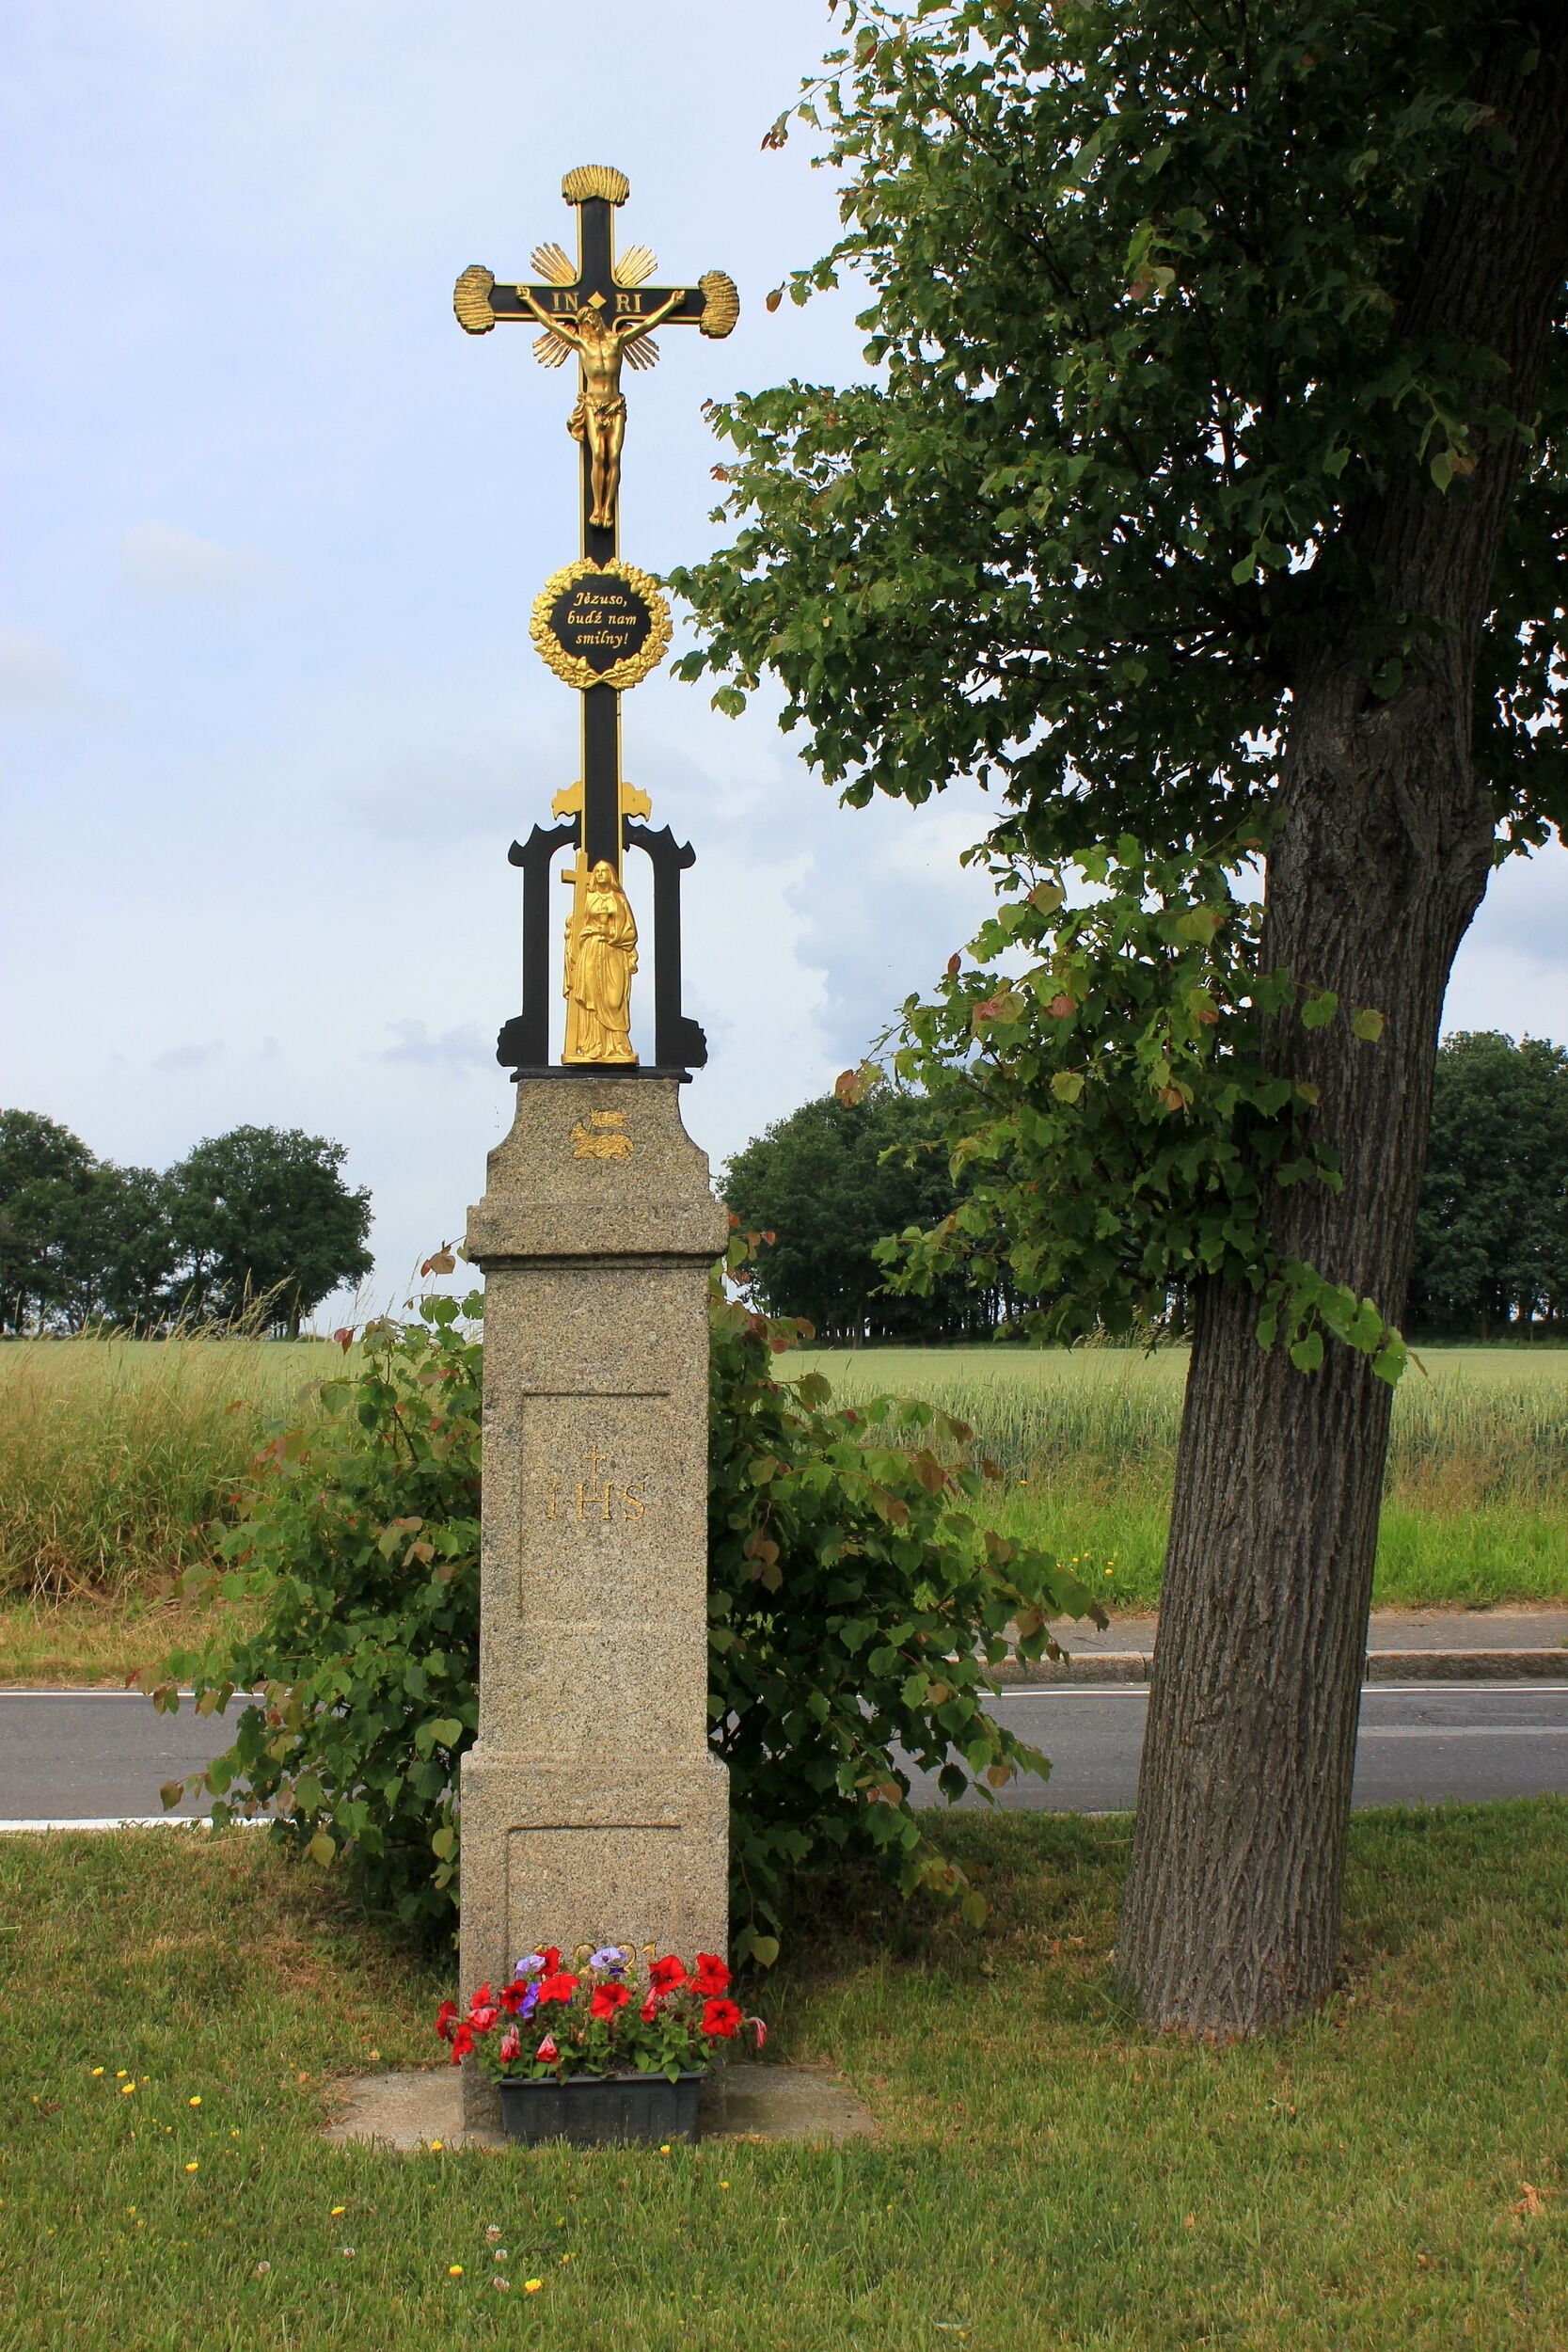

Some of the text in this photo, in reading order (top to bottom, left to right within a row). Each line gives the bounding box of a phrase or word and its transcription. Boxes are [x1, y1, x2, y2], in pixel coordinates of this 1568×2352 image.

[552, 292, 642, 313] IN RI
[608, 614, 637, 626] nam
[575, 630, 629, 649] smilny!
[547, 1480, 647, 1522] IHS
